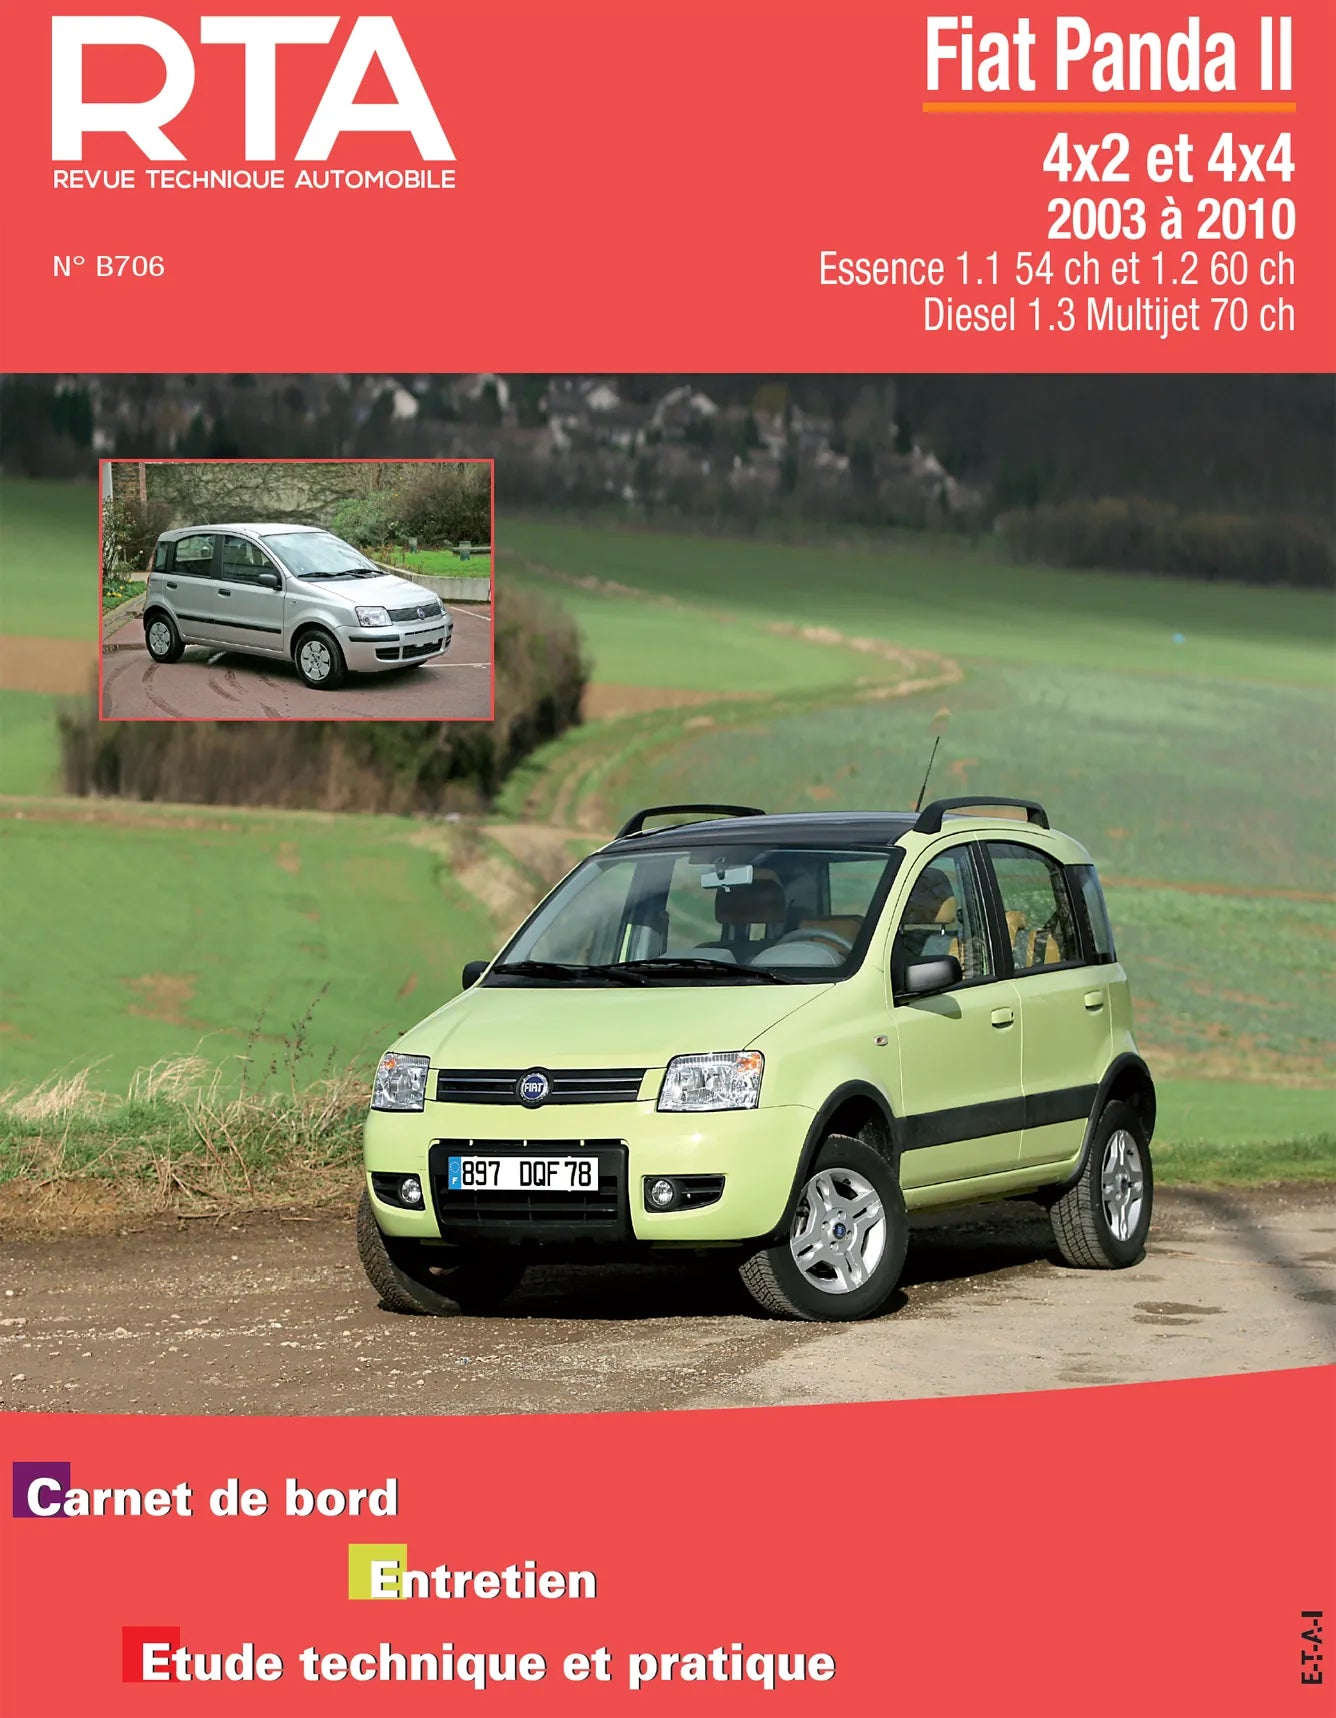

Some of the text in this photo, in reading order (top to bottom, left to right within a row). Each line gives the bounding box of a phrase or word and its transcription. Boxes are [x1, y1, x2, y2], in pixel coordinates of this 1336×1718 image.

[523, 1082, 544, 1093] FIAT
[463, 1161, 591, 1186] 897 DQF 78
